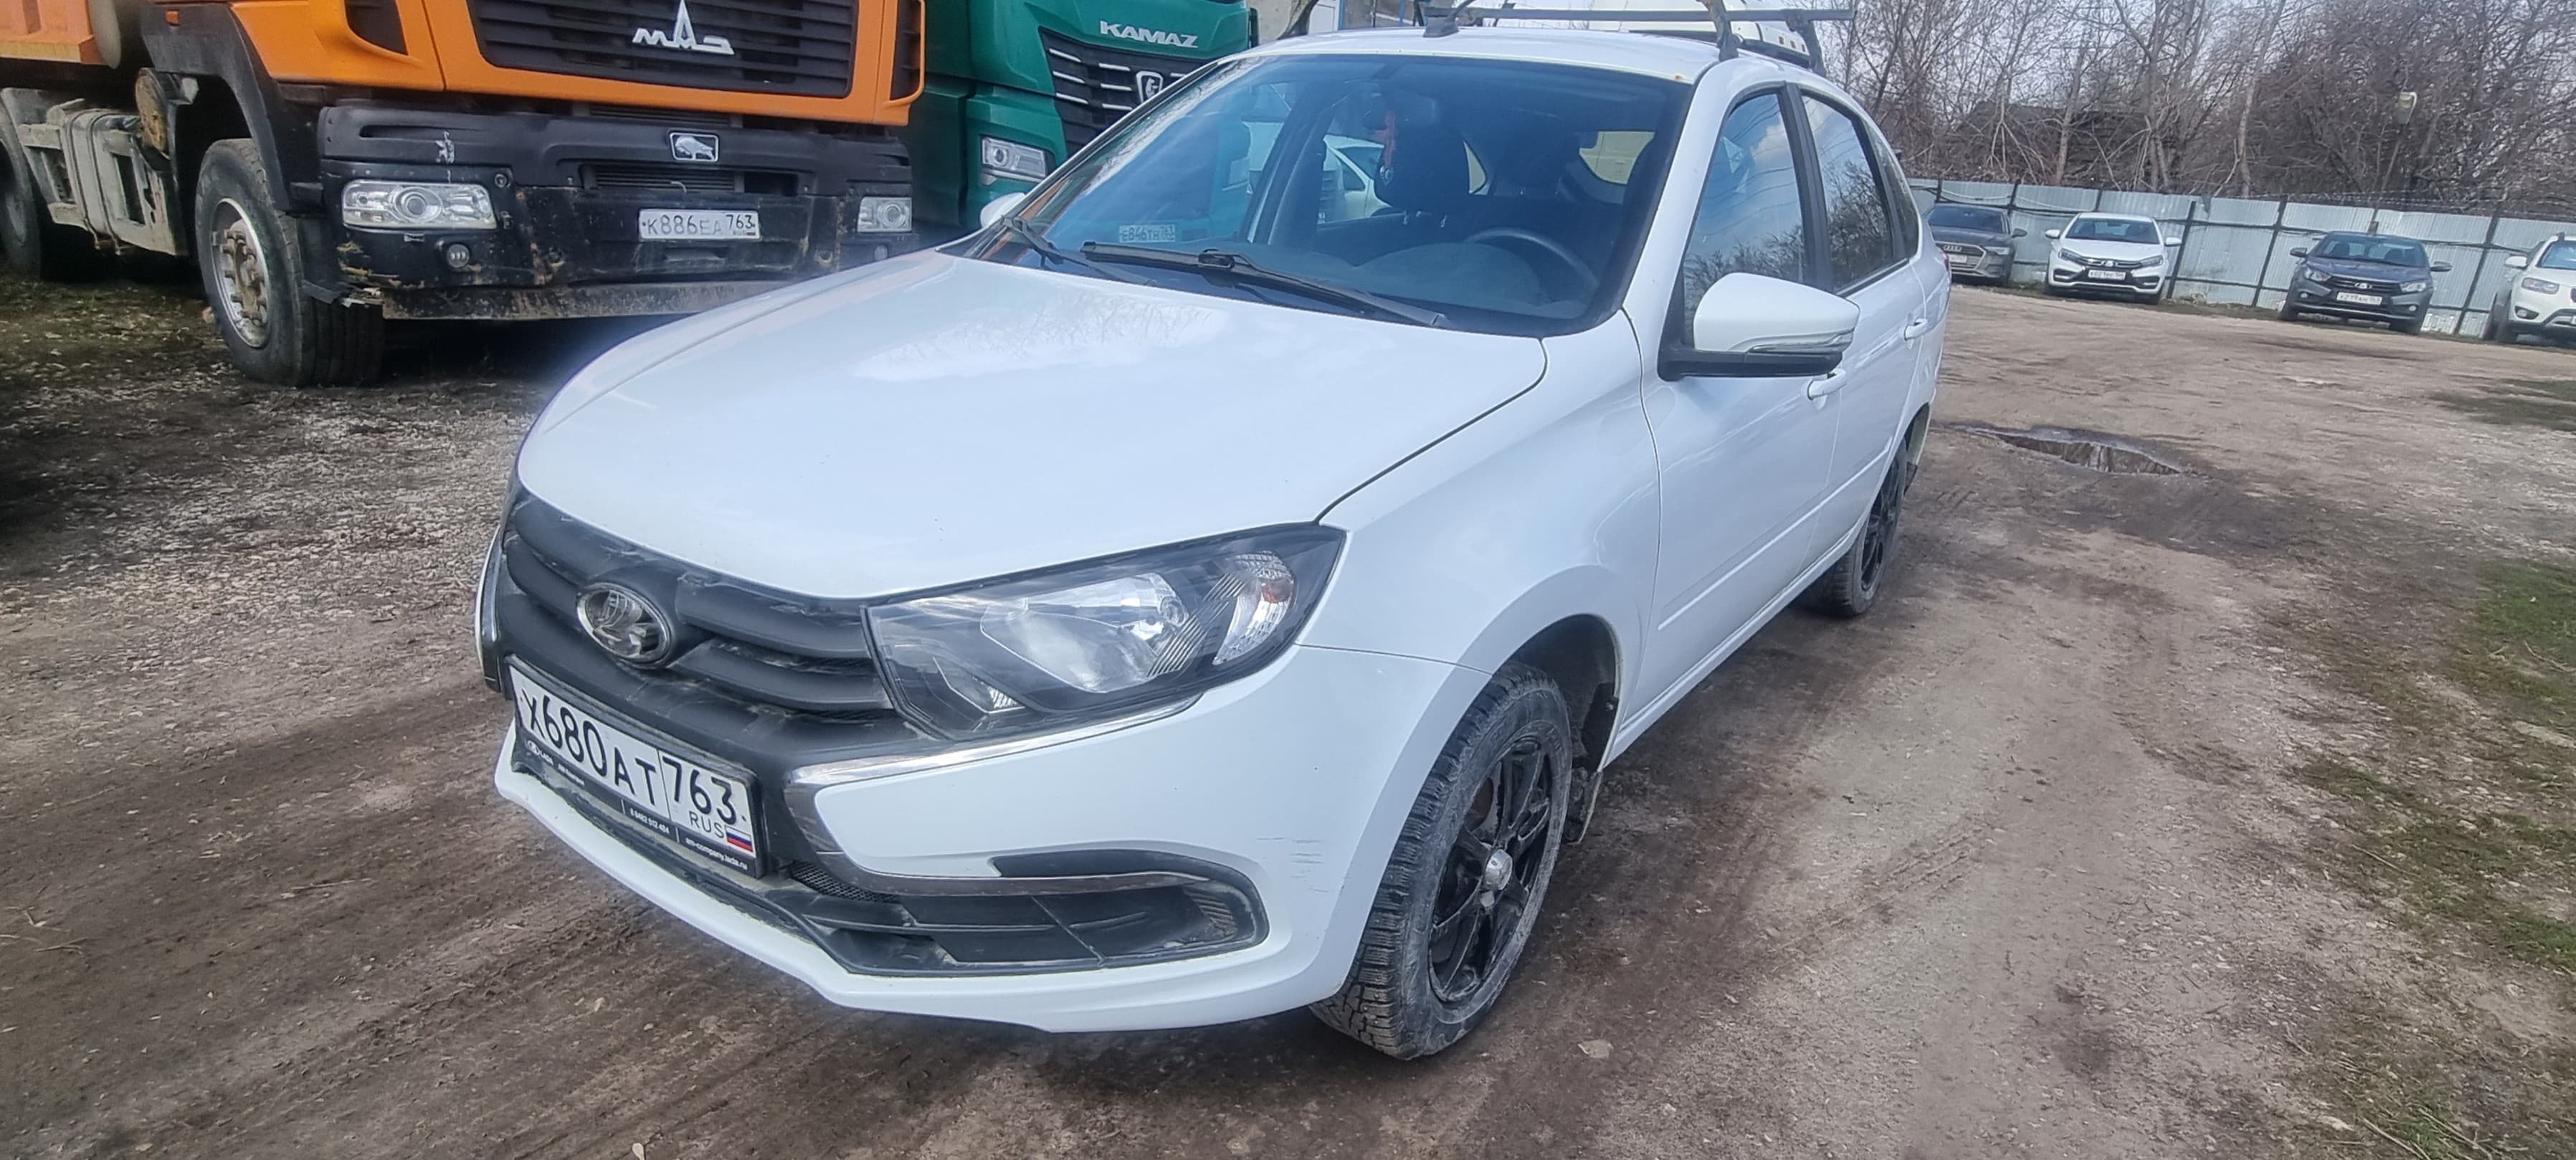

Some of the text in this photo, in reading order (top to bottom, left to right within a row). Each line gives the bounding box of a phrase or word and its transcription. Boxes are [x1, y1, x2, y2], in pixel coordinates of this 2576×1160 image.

[1100, 20, 1199, 49] KAMAZ
[647, 214, 752, 236] К886ЕА 763
[521, 688, 737, 826] Х680АТ 763
[689, 810, 725, 840] RUS
